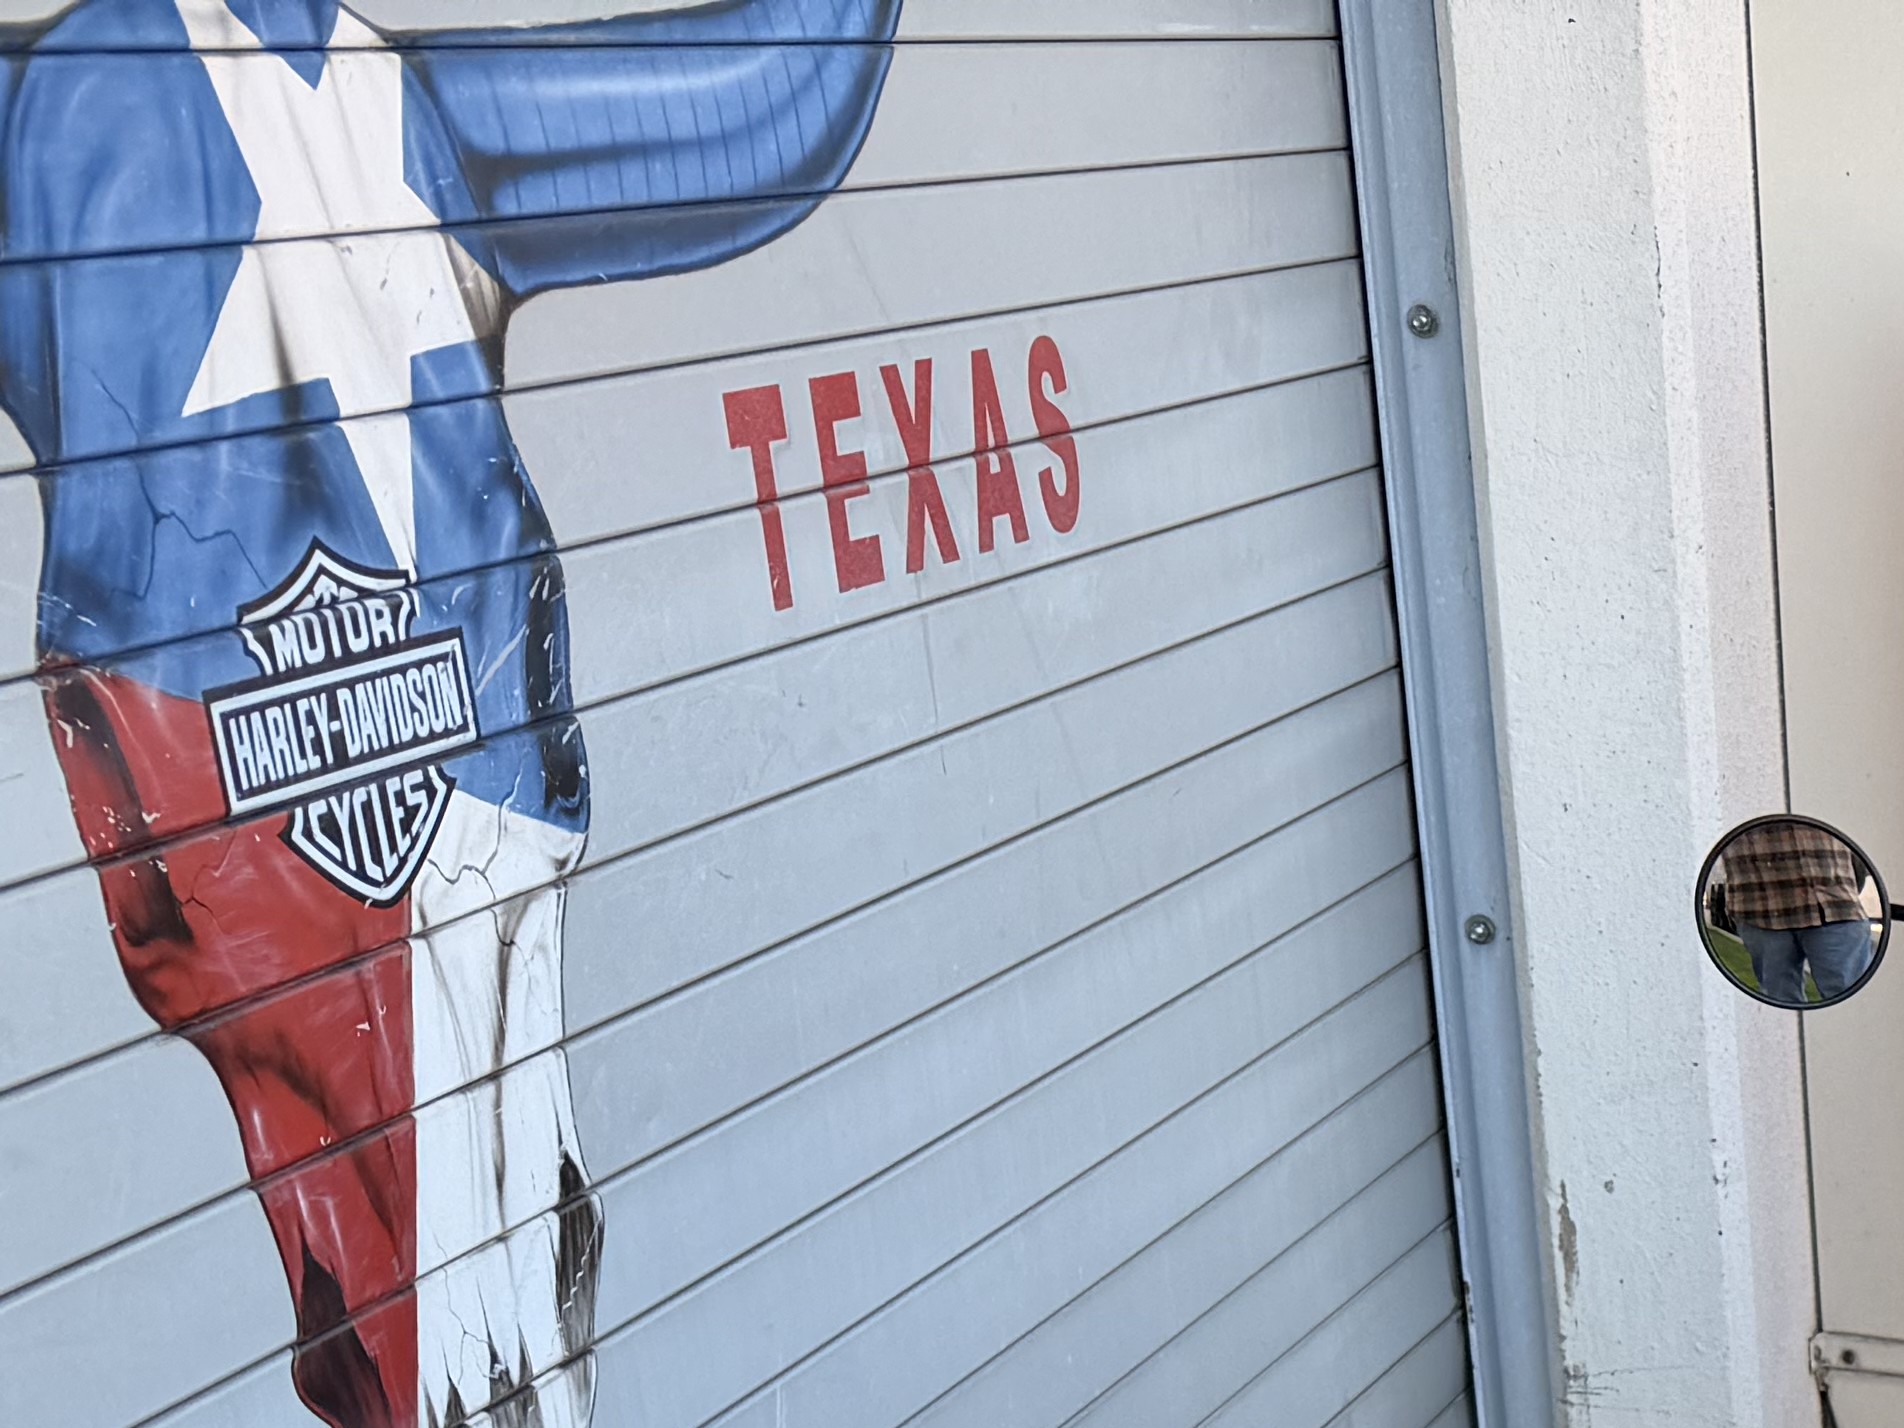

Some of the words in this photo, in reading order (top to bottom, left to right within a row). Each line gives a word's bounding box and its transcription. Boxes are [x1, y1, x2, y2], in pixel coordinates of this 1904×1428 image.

[722, 335, 1081, 612] TEXAS
[268, 598, 395, 675] MOTOR
[228, 661, 462, 791] HARLEY-DAVIDSON
[308, 765, 427, 882] CYCLES
